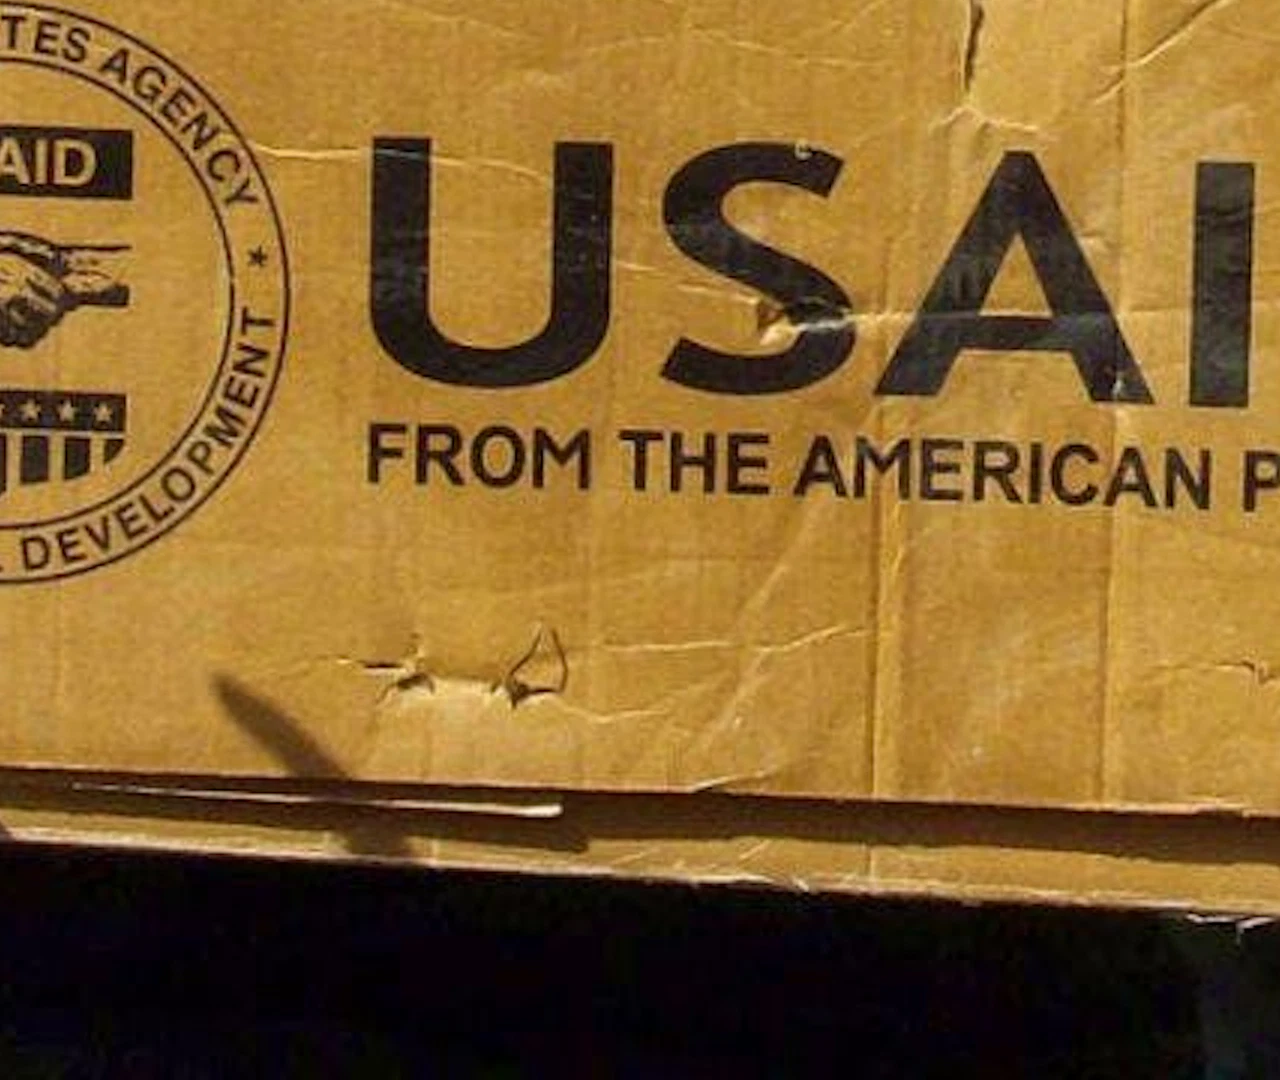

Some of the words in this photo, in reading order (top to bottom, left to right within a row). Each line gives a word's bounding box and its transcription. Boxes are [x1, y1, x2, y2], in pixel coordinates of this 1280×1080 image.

[100, 46, 260, 212] AGENCY
[22, 307, 276, 572] DEVELOPMENT
[366, 422, 592, 491] FROM
[622, 430, 771, 497] THE
[793, 432, 1211, 511] AMERICAN
